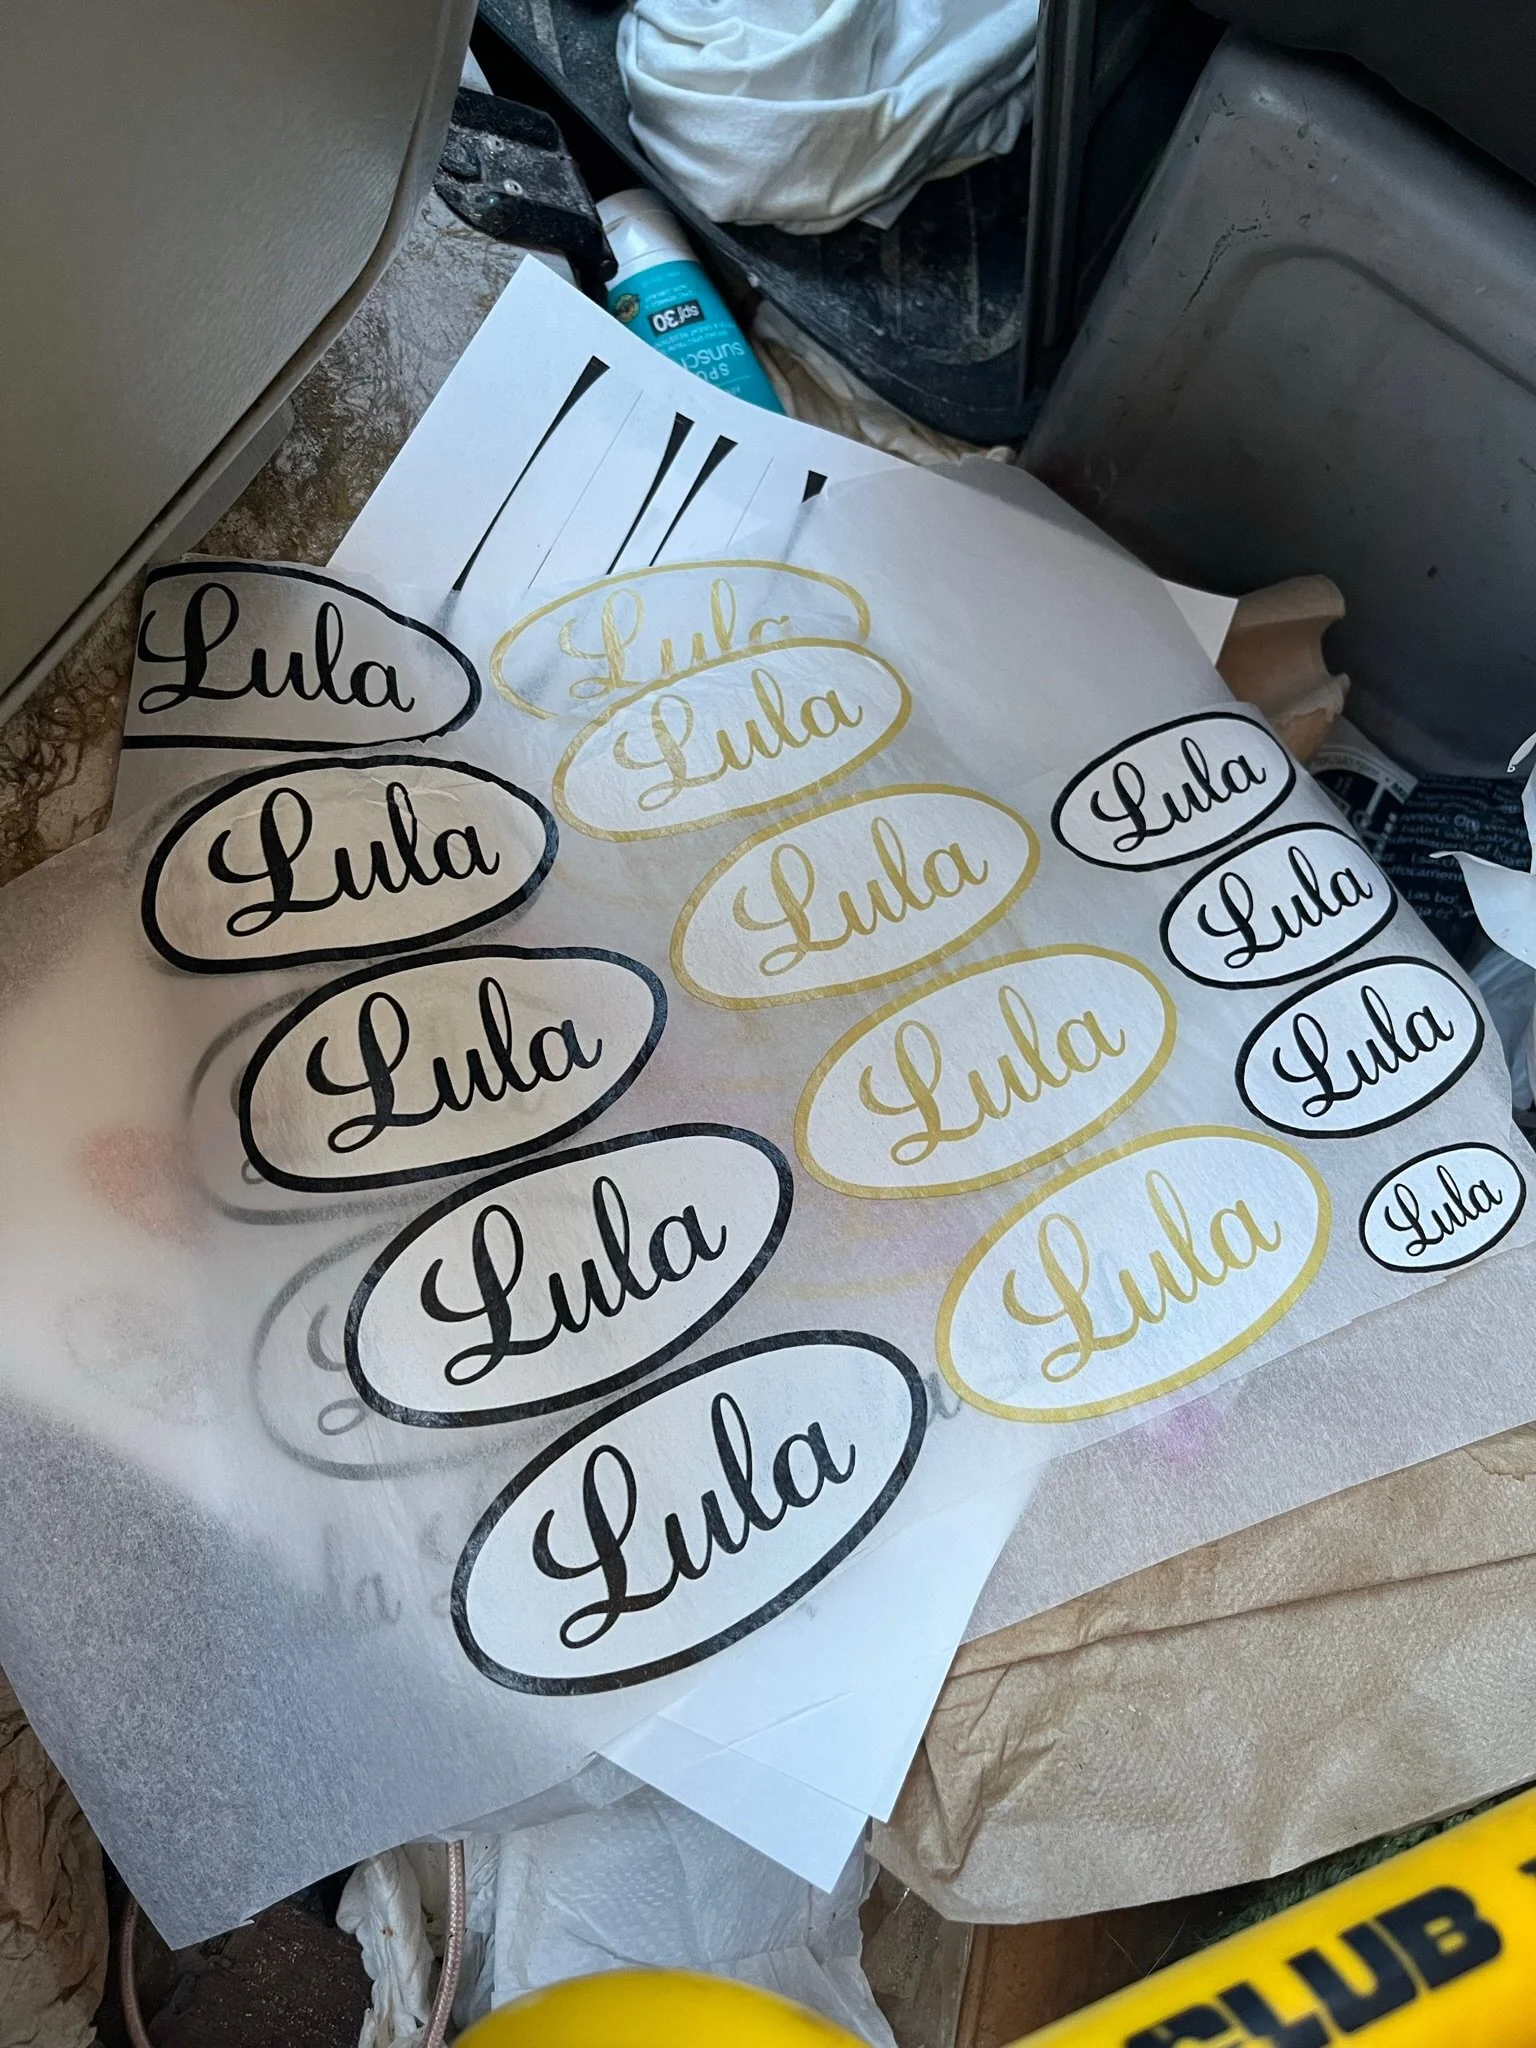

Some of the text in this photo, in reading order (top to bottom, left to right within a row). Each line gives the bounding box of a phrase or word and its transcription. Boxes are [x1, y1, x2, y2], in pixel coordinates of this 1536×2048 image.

[652, 304, 700, 332] spf 30
[137, 582, 415, 715] Lula
[612, 667, 864, 812] Lula
[1090, 736, 1267, 853] Lula
[207, 781, 501, 938] Lula
[732, 815, 989, 977] Lula
[1197, 845, 1374, 969] Lula
[305, 972, 603, 1154] Lula
[859, 984, 1127, 1166] Lula
[1272, 985, 1455, 1118] Lula
[420, 1175, 727, 1386] Lula
[1002, 1168, 1282, 1384] Lula
[1384, 1164, 1503, 1257] Lula
[532, 1392, 856, 1649] Lula
